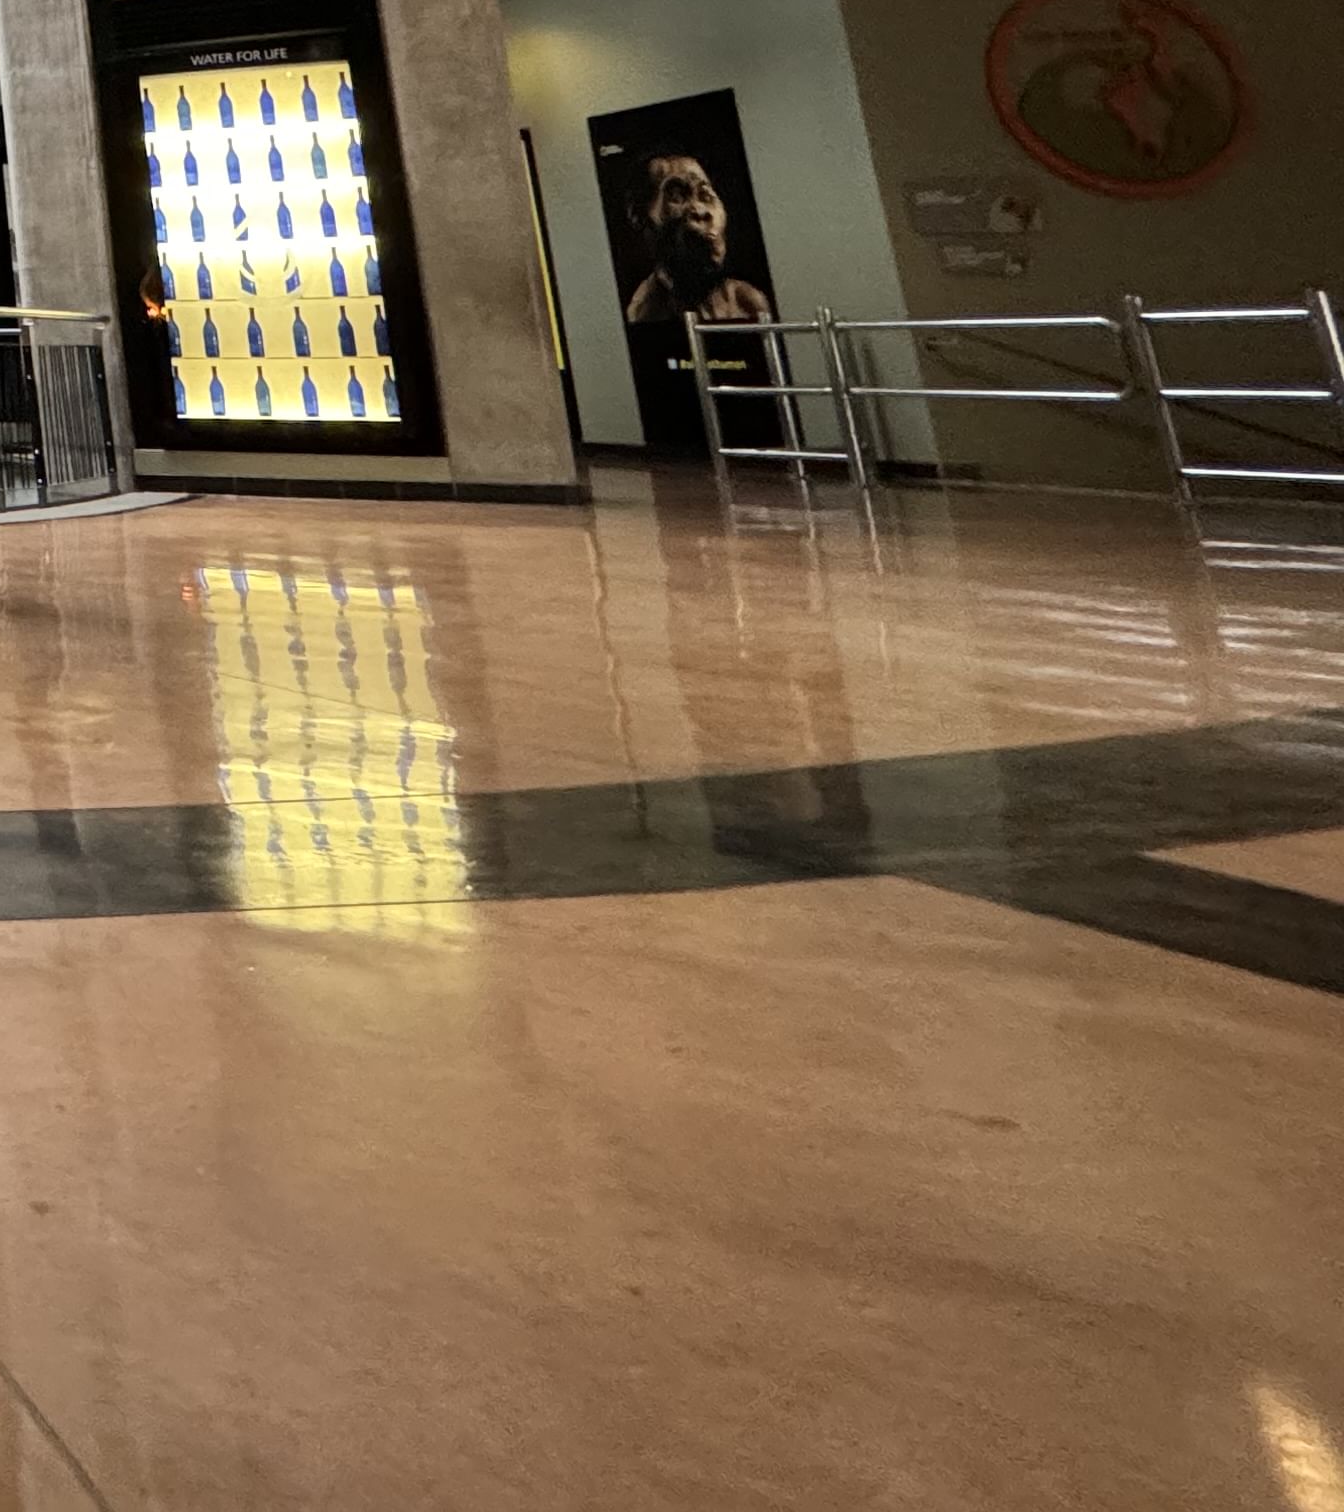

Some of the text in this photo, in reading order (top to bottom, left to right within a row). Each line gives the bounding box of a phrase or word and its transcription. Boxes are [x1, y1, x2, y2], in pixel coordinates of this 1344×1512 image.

[190, 47, 288, 66] WATER FOR LIFE
